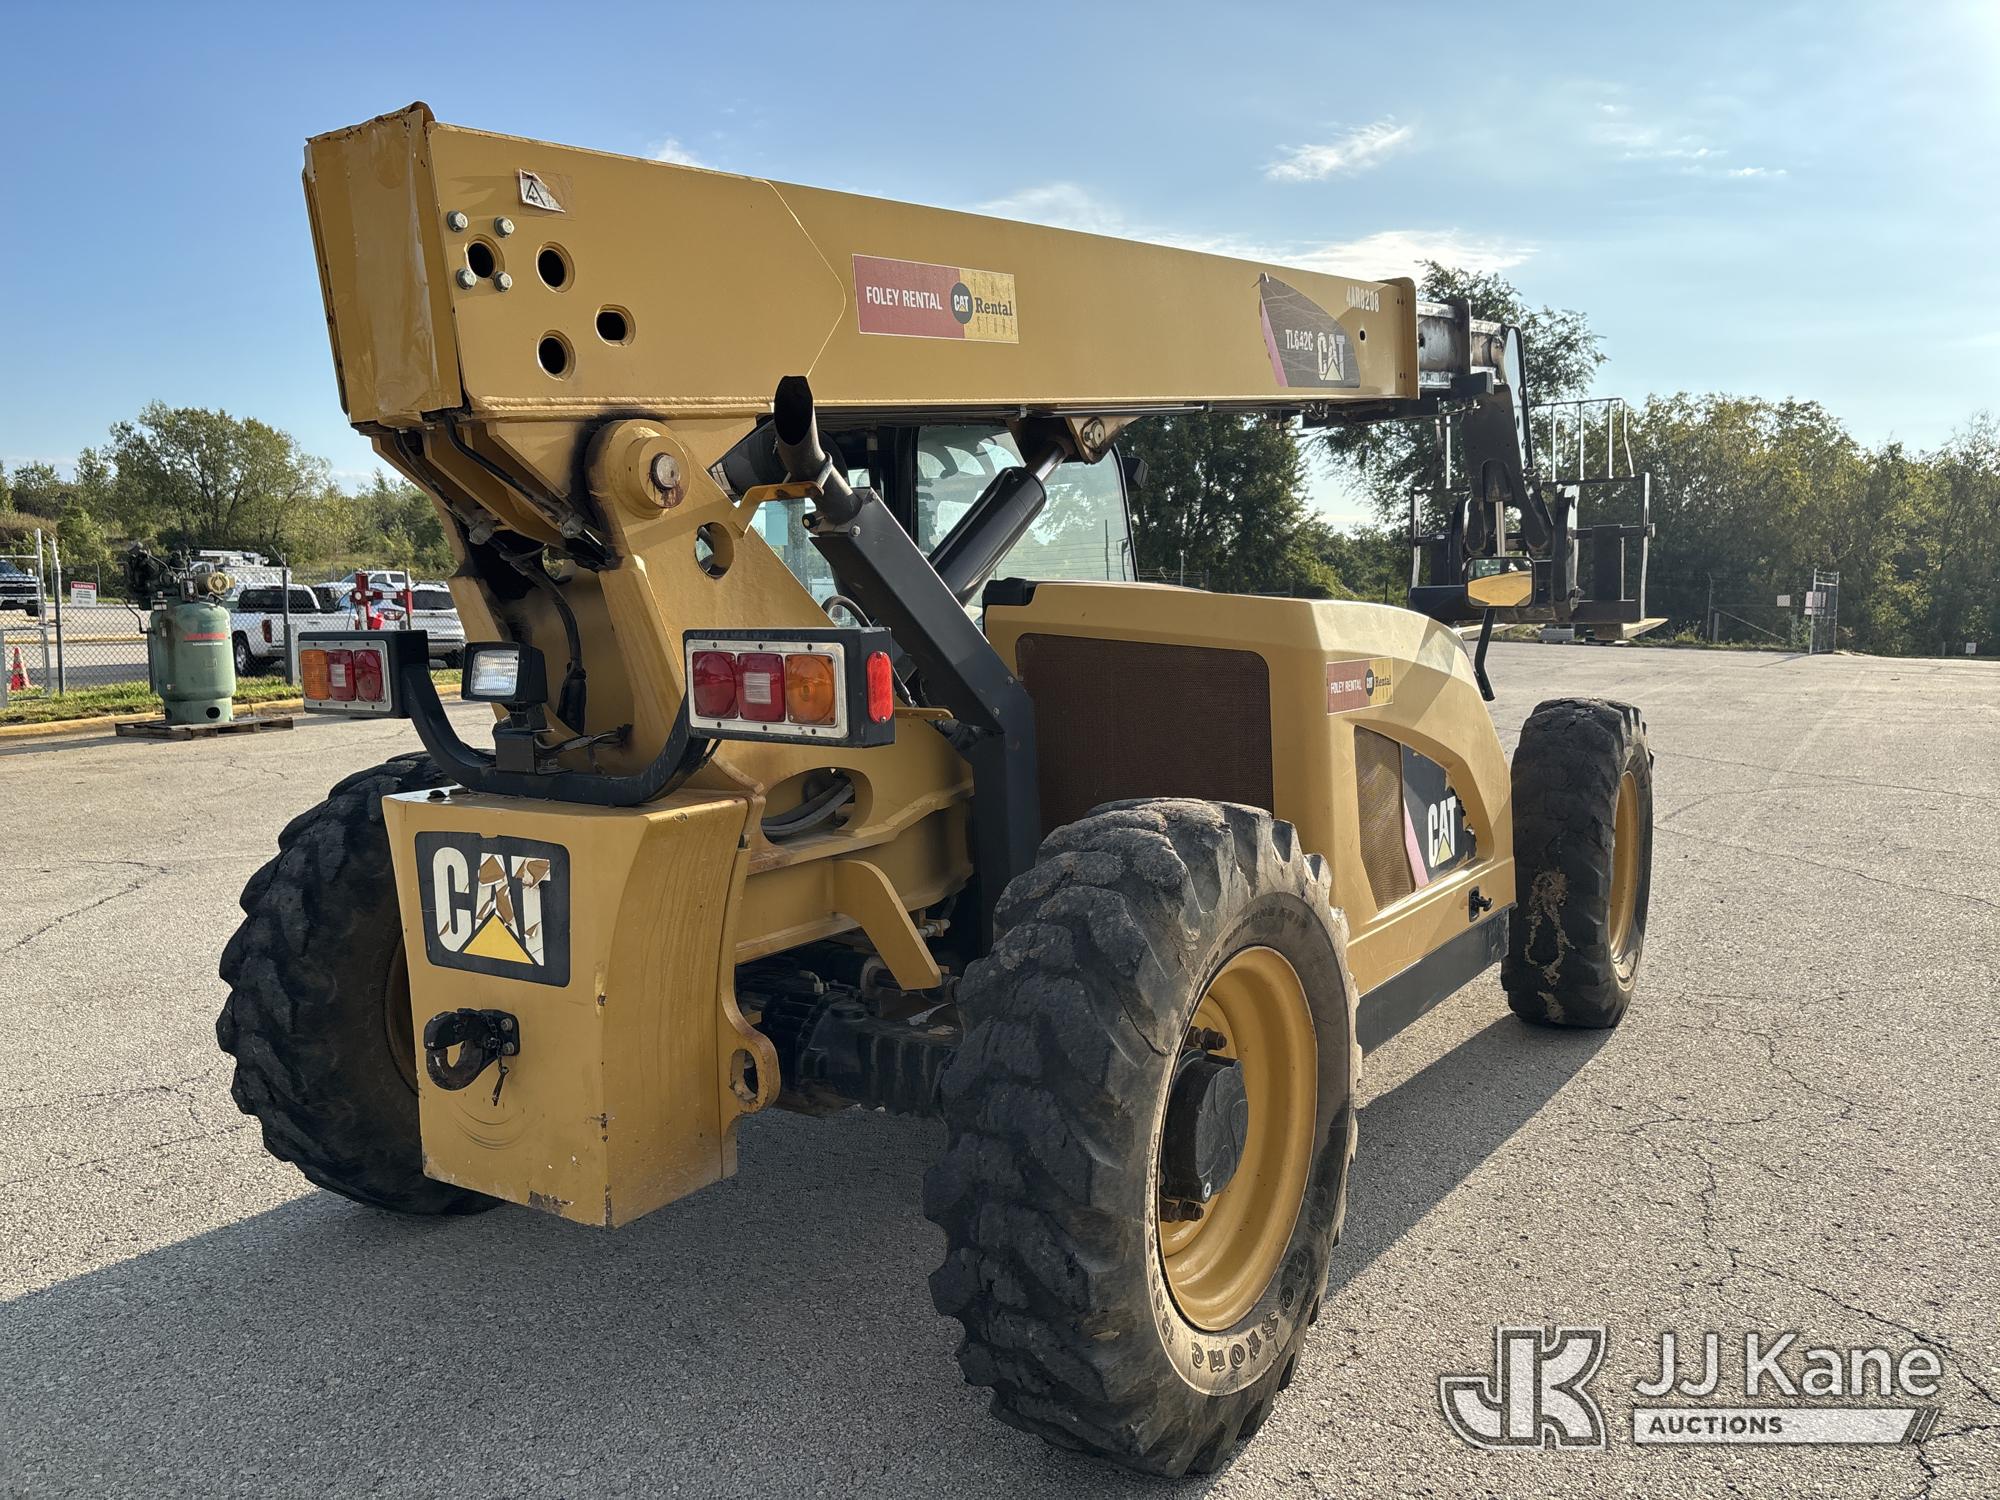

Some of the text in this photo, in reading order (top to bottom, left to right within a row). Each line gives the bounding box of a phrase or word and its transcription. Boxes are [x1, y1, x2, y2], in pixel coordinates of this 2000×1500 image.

[866, 286, 943, 310] FOLEY RENTAL
[953, 295, 1013, 316] CAT Rental
[1285, 329, 1313, 351] TL642C
[1317, 332, 1345, 381] CAT
[1330, 679, 1362, 695] FOLEY RENTAL
[1375, 675, 1391, 687] Rental
[1427, 796, 1457, 868] CAT
[433, 847, 551, 966] CAT
